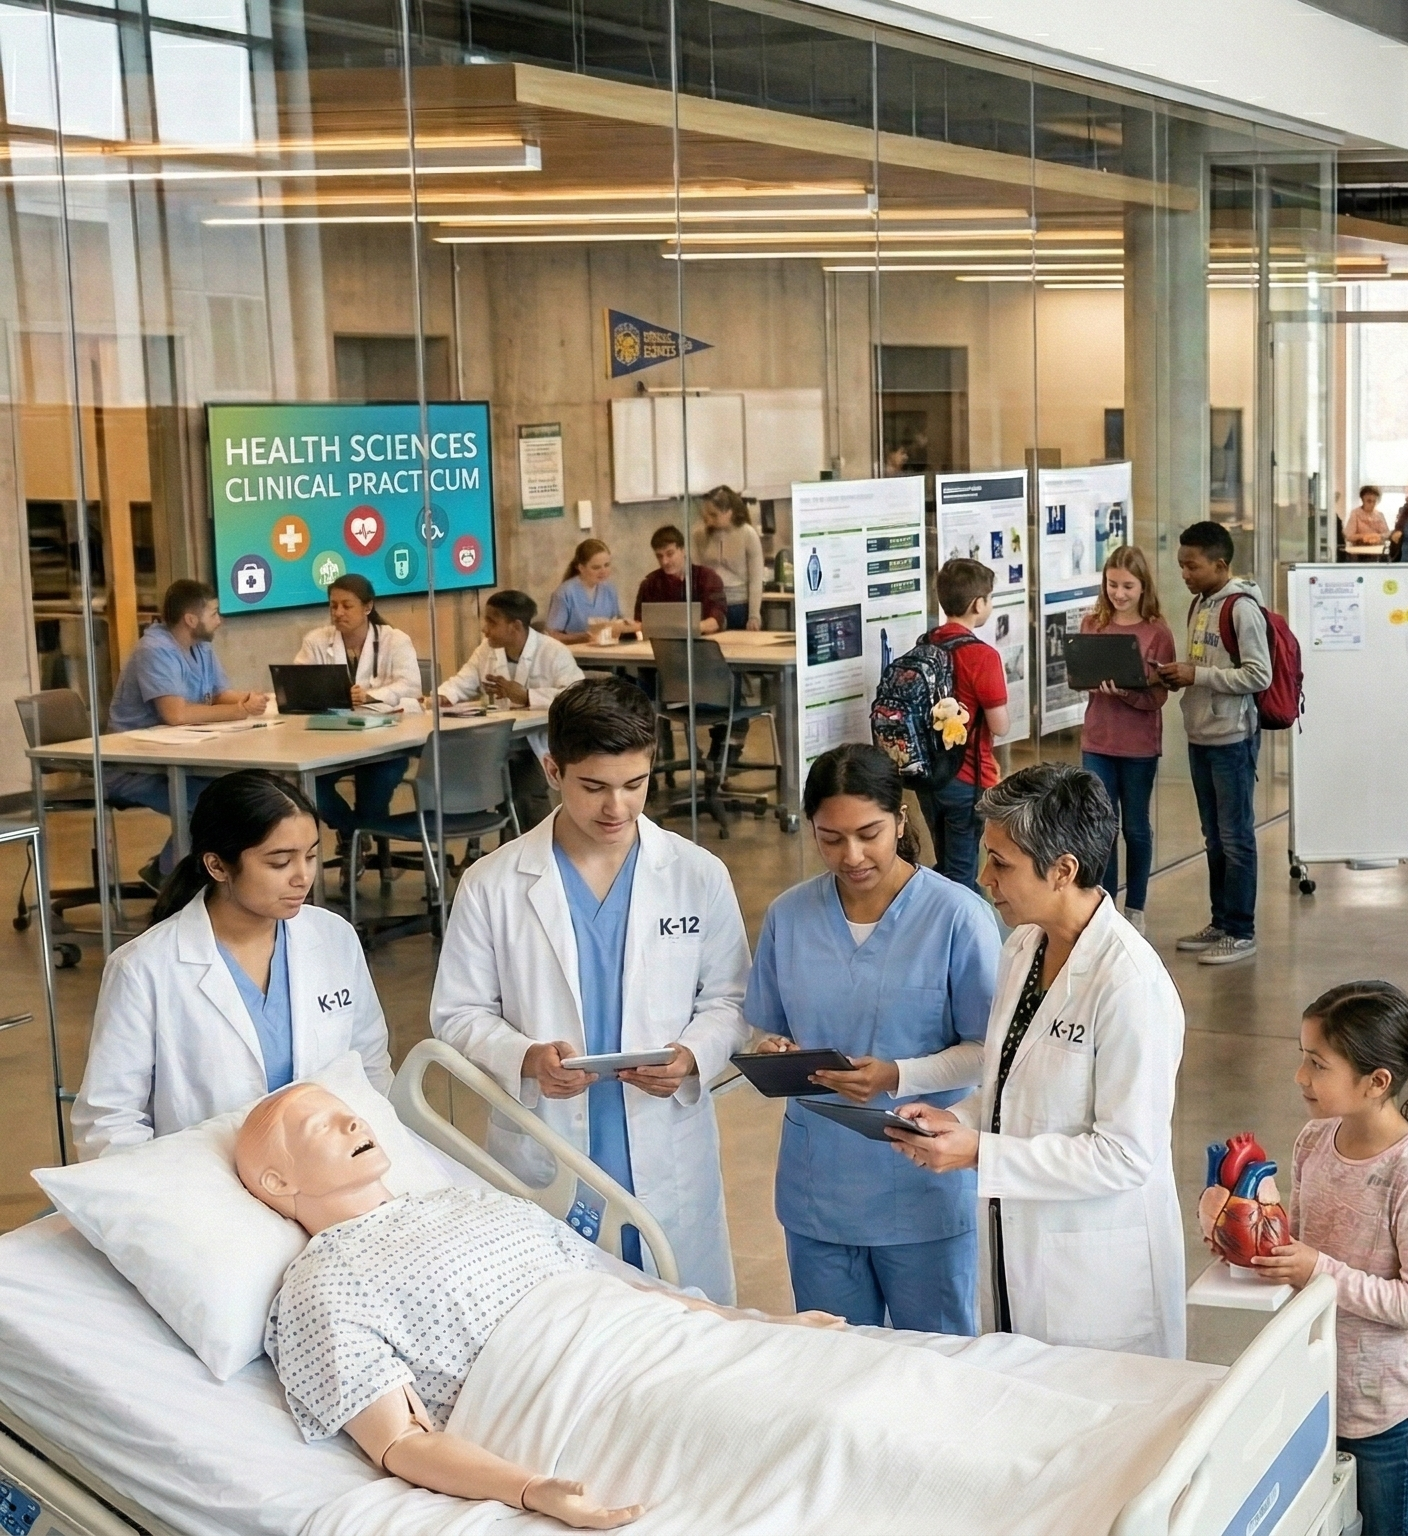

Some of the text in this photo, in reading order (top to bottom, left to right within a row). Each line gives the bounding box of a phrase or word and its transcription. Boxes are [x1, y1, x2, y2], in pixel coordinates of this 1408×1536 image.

[225, 432, 478, 466] HEALTH SCIENCES
[225, 467, 480, 503] CLINICAL PRACTICUM
[659, 915, 700, 936] K-12
[317, 988, 353, 1014] K-12
[1049, 1018, 1086, 1044] K-12
